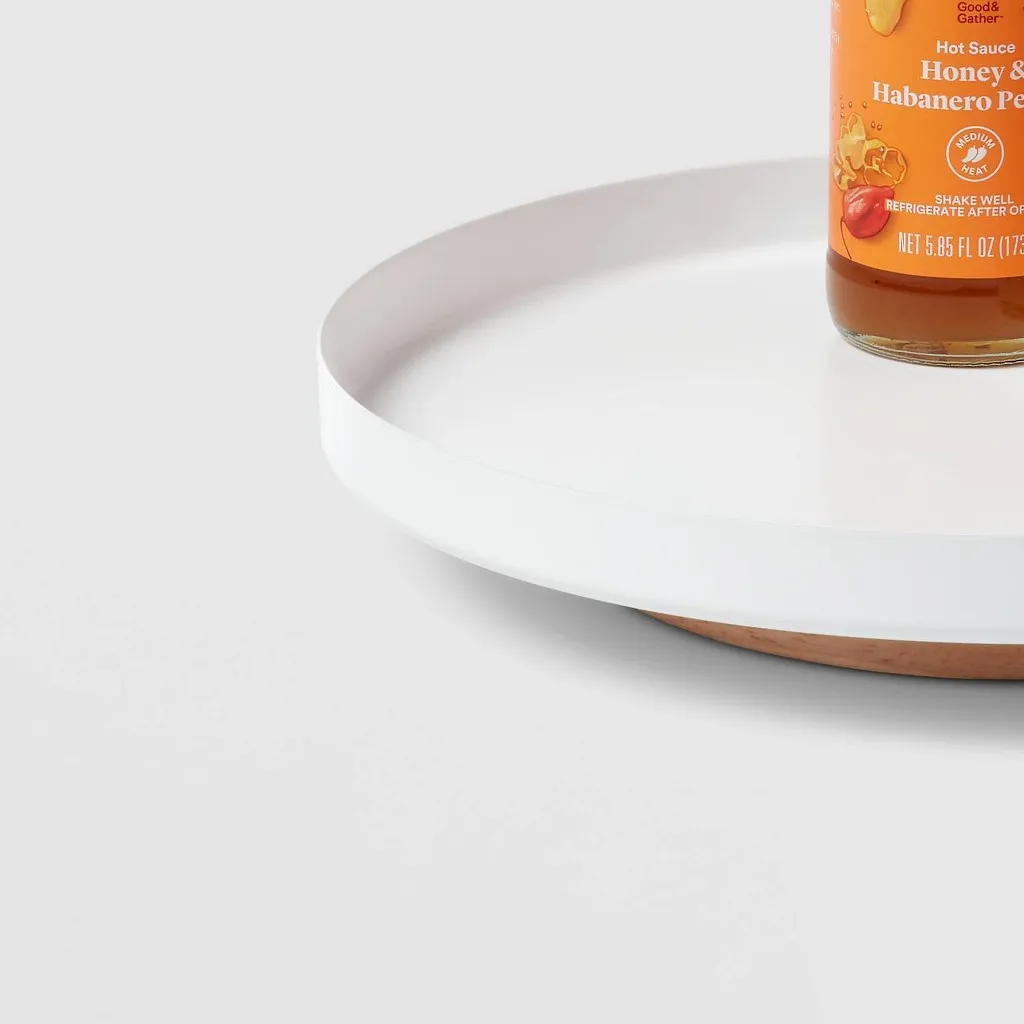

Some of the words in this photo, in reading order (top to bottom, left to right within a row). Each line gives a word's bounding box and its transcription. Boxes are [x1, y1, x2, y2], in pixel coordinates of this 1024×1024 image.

[957, 2, 1000, 12] Good&
[936, 40, 965, 55] Hot
[969, 41, 1016, 55] Sauce
[920, 60, 1004, 87] Honey
[872, 81, 992, 111] Habanero
[955, 132, 996, 149] MEDIUM
[961, 164, 989, 176] HEAT
[886, 199, 965, 217] REFRIGERATE
[967, 205, 1006, 217] AFTER
[935, 194, 977, 205] SHAKE
[979, 194, 1015, 205] WELL
[898, 231, 921, 255] NET
[925, 235, 953, 257] 5.85
[958, 235, 972, 258] FL
[978, 235, 994, 258] OZ
